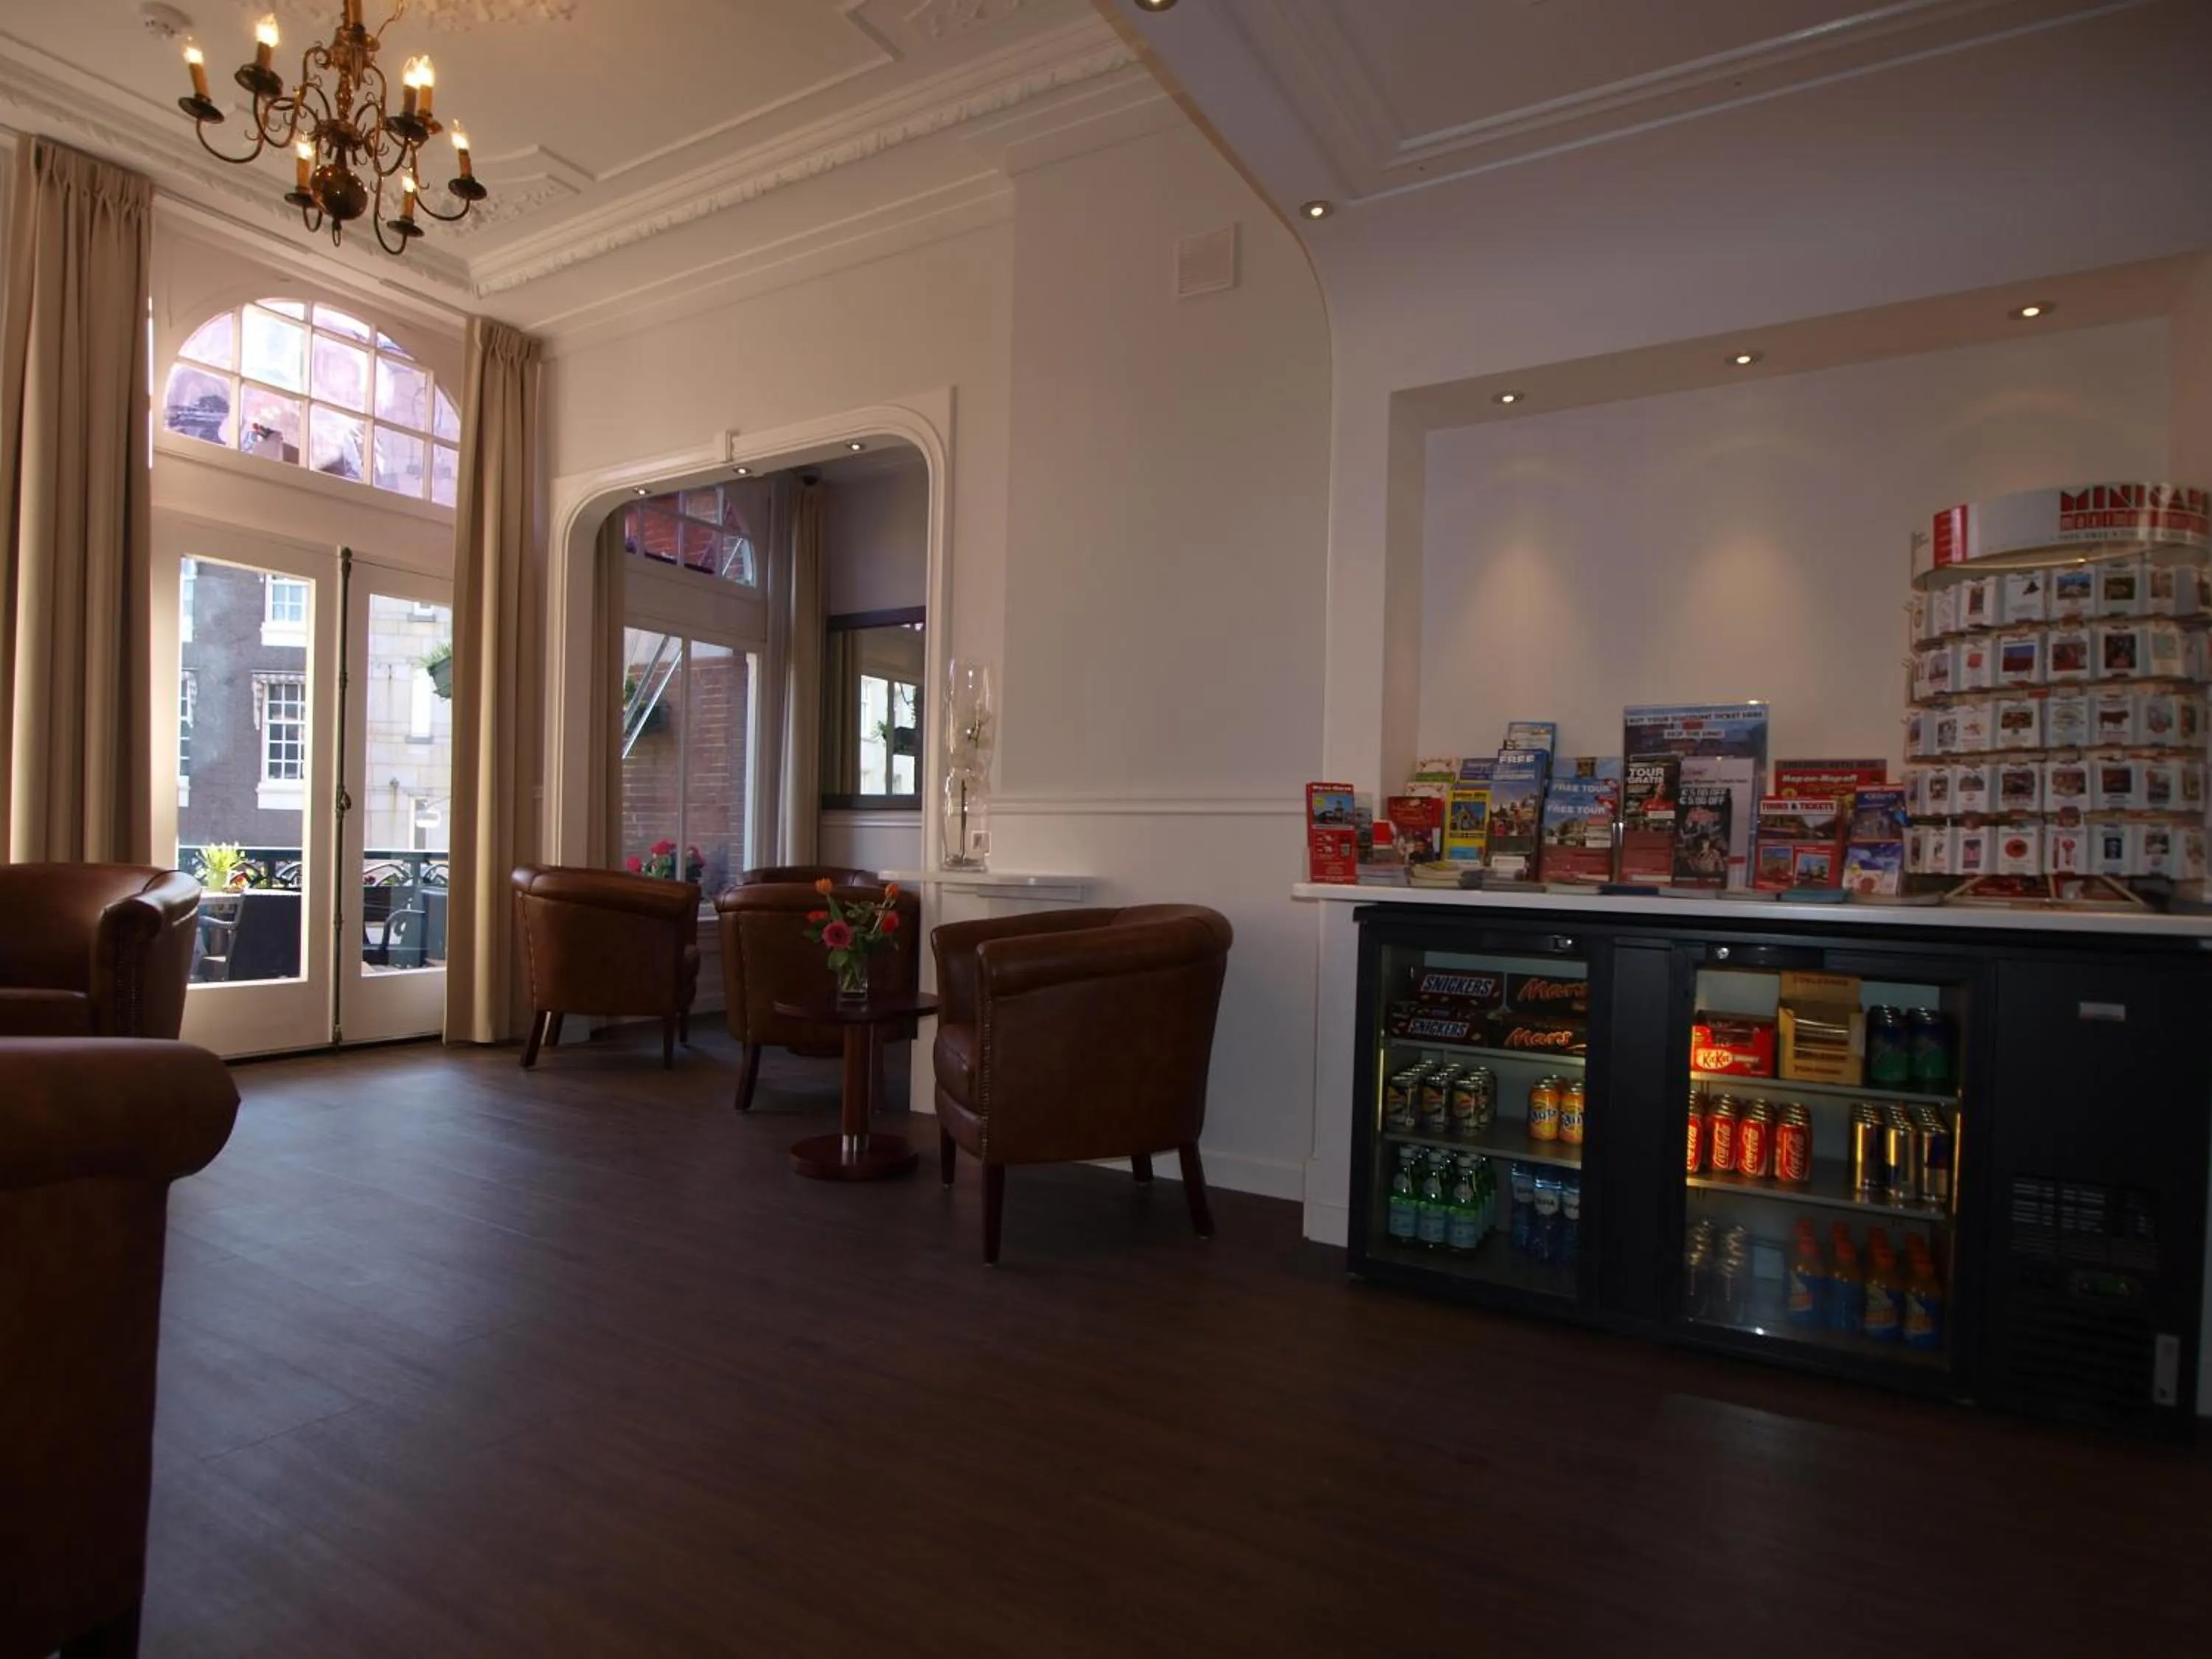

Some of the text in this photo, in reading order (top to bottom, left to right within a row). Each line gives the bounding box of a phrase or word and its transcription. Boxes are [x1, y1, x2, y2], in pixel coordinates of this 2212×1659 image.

[1499, 754, 1535, 764] FREE
[1627, 776, 1664, 785] GRATIS
[1628, 767, 1664, 777] TOUR
[1552, 782, 1610, 793] FREE TOUR
[1547, 804, 1606, 815] FREE TOUR
[1425, 975, 1492, 997] SNICKERS
[1517, 978, 1587, 1002] Mars
[1411, 1019, 1467, 1037] SNICKERS
[1503, 1027, 1573, 1046] Mars
[1703, 1051, 1730, 1068] KitKat
[1533, 1108, 1557, 1121] anta
[1713, 1122, 1731, 1169] Coca-Cola
[1742, 1125, 1759, 1175] Coca-Cola
[1784, 1130, 1804, 1180] Coca-Cola
